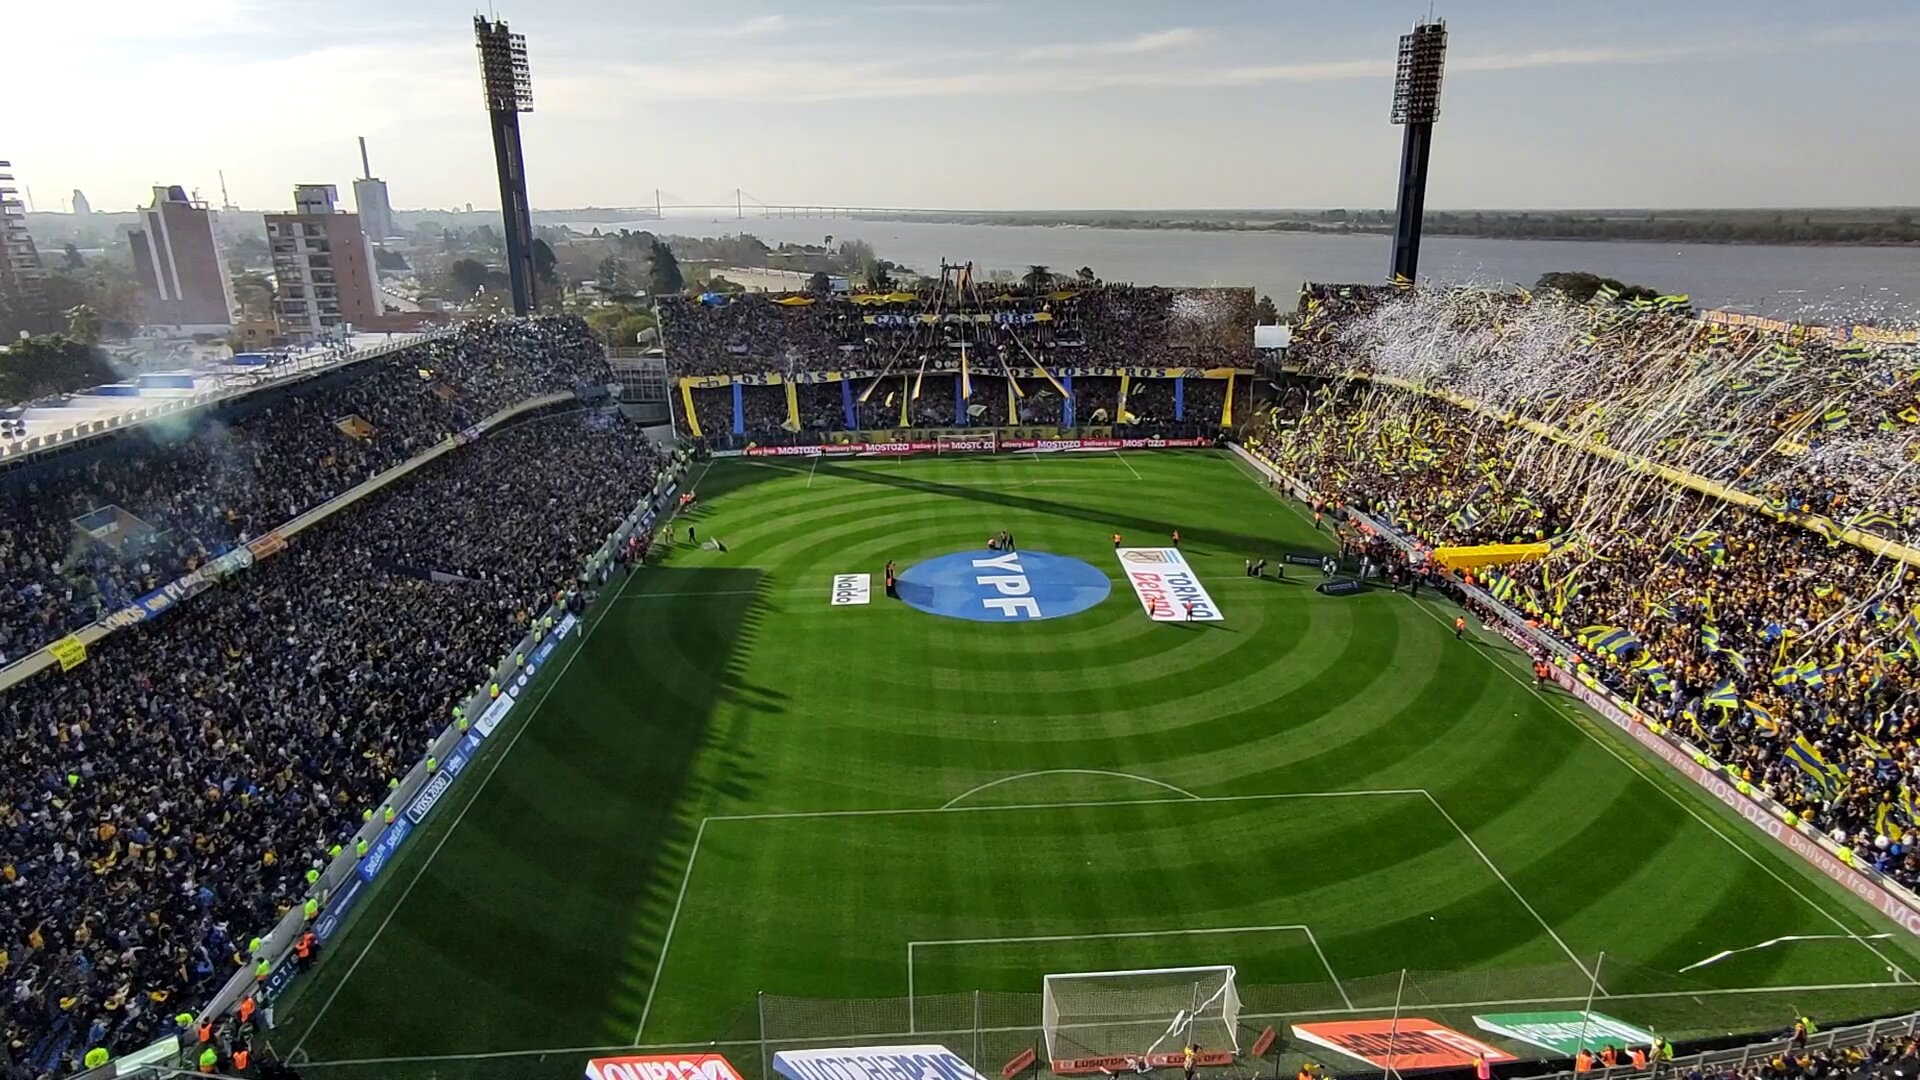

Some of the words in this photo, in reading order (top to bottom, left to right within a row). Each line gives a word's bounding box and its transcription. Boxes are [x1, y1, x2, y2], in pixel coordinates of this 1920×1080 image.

[836, 575, 859, 603] Naldo
[972, 552, 1042, 618] YPF
[1131, 572, 1176, 618] Betano
[1164, 571, 1214, 618] TORNEO
[1635, 727, 1674, 762] Delivery
[1673, 756, 1695, 775] free
[1789, 833, 1845, 881] Delivery
[1847, 874, 1877, 901] free
